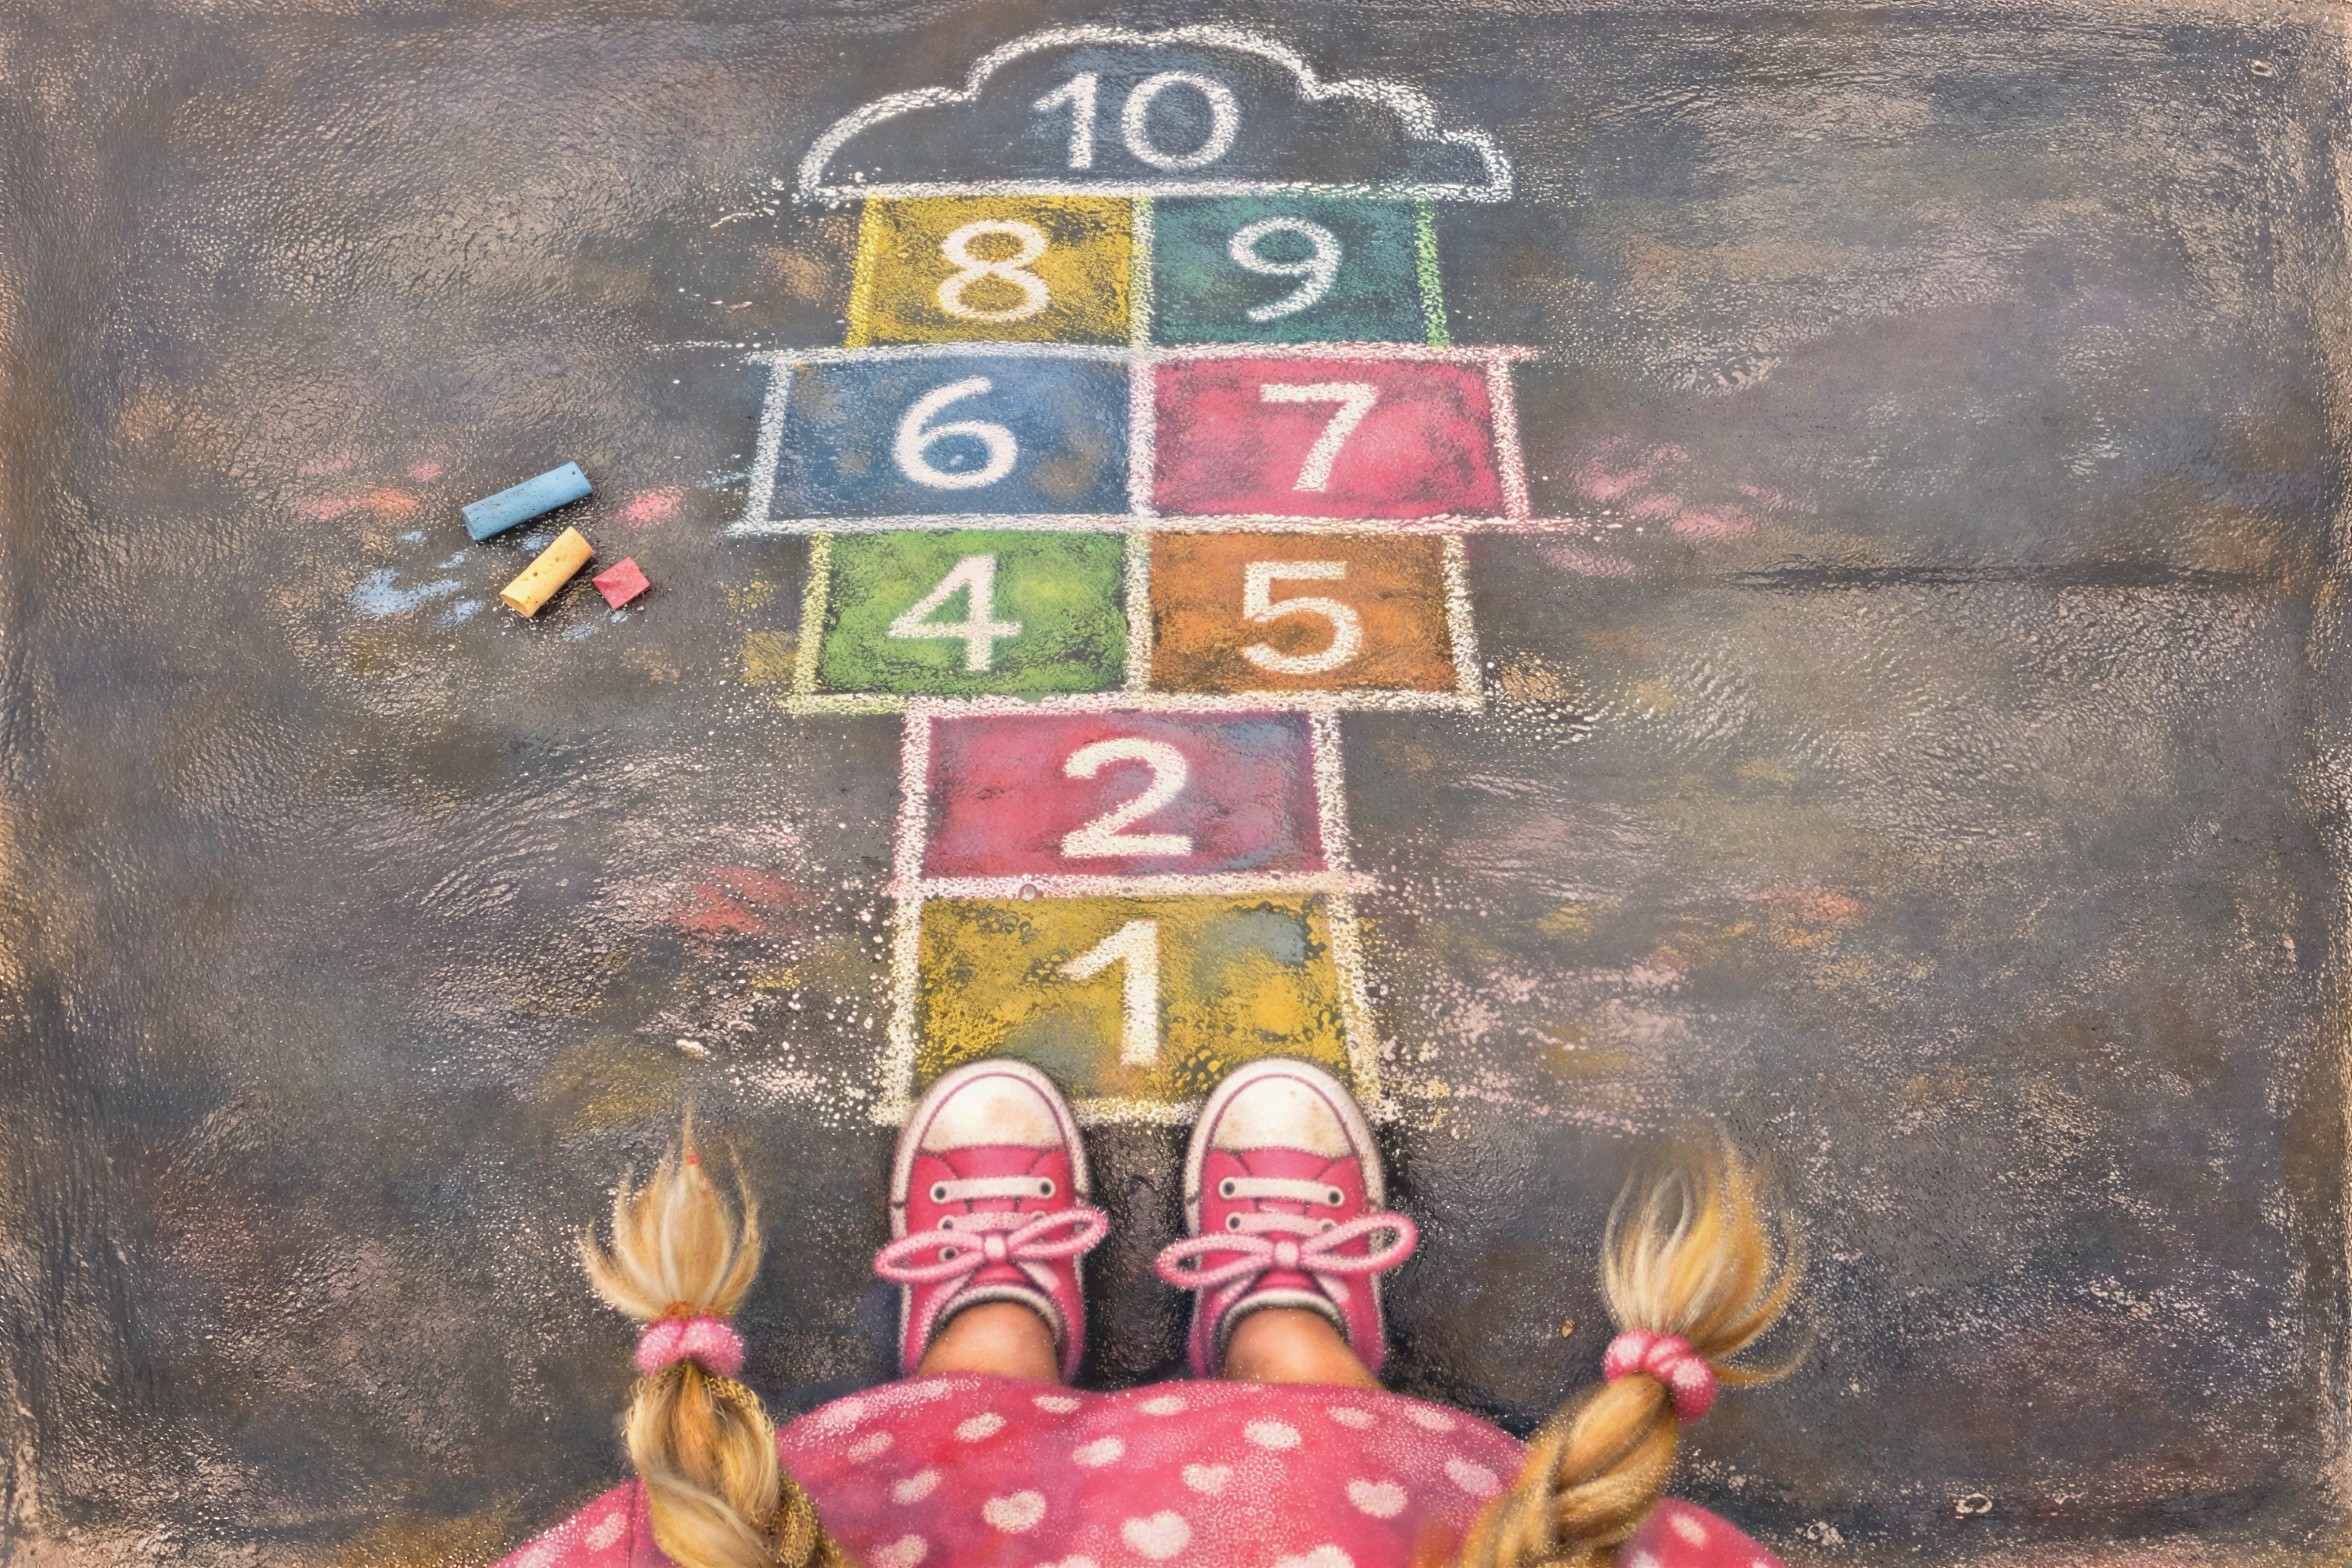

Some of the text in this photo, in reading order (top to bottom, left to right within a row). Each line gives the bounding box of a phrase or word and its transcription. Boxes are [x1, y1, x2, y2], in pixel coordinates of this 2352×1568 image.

[1033, 71, 1240, 171] 10
[937, 218, 1050, 323] 8
[1229, 216, 1343, 322] 9
[893, 376, 1018, 490] 6
[1258, 381, 1380, 493] 7
[887, 553, 1023, 673] 4
[1239, 559, 1363, 676] 5
[1061, 737, 1193, 860] 2
[1062, 918, 1162, 1067] 1
